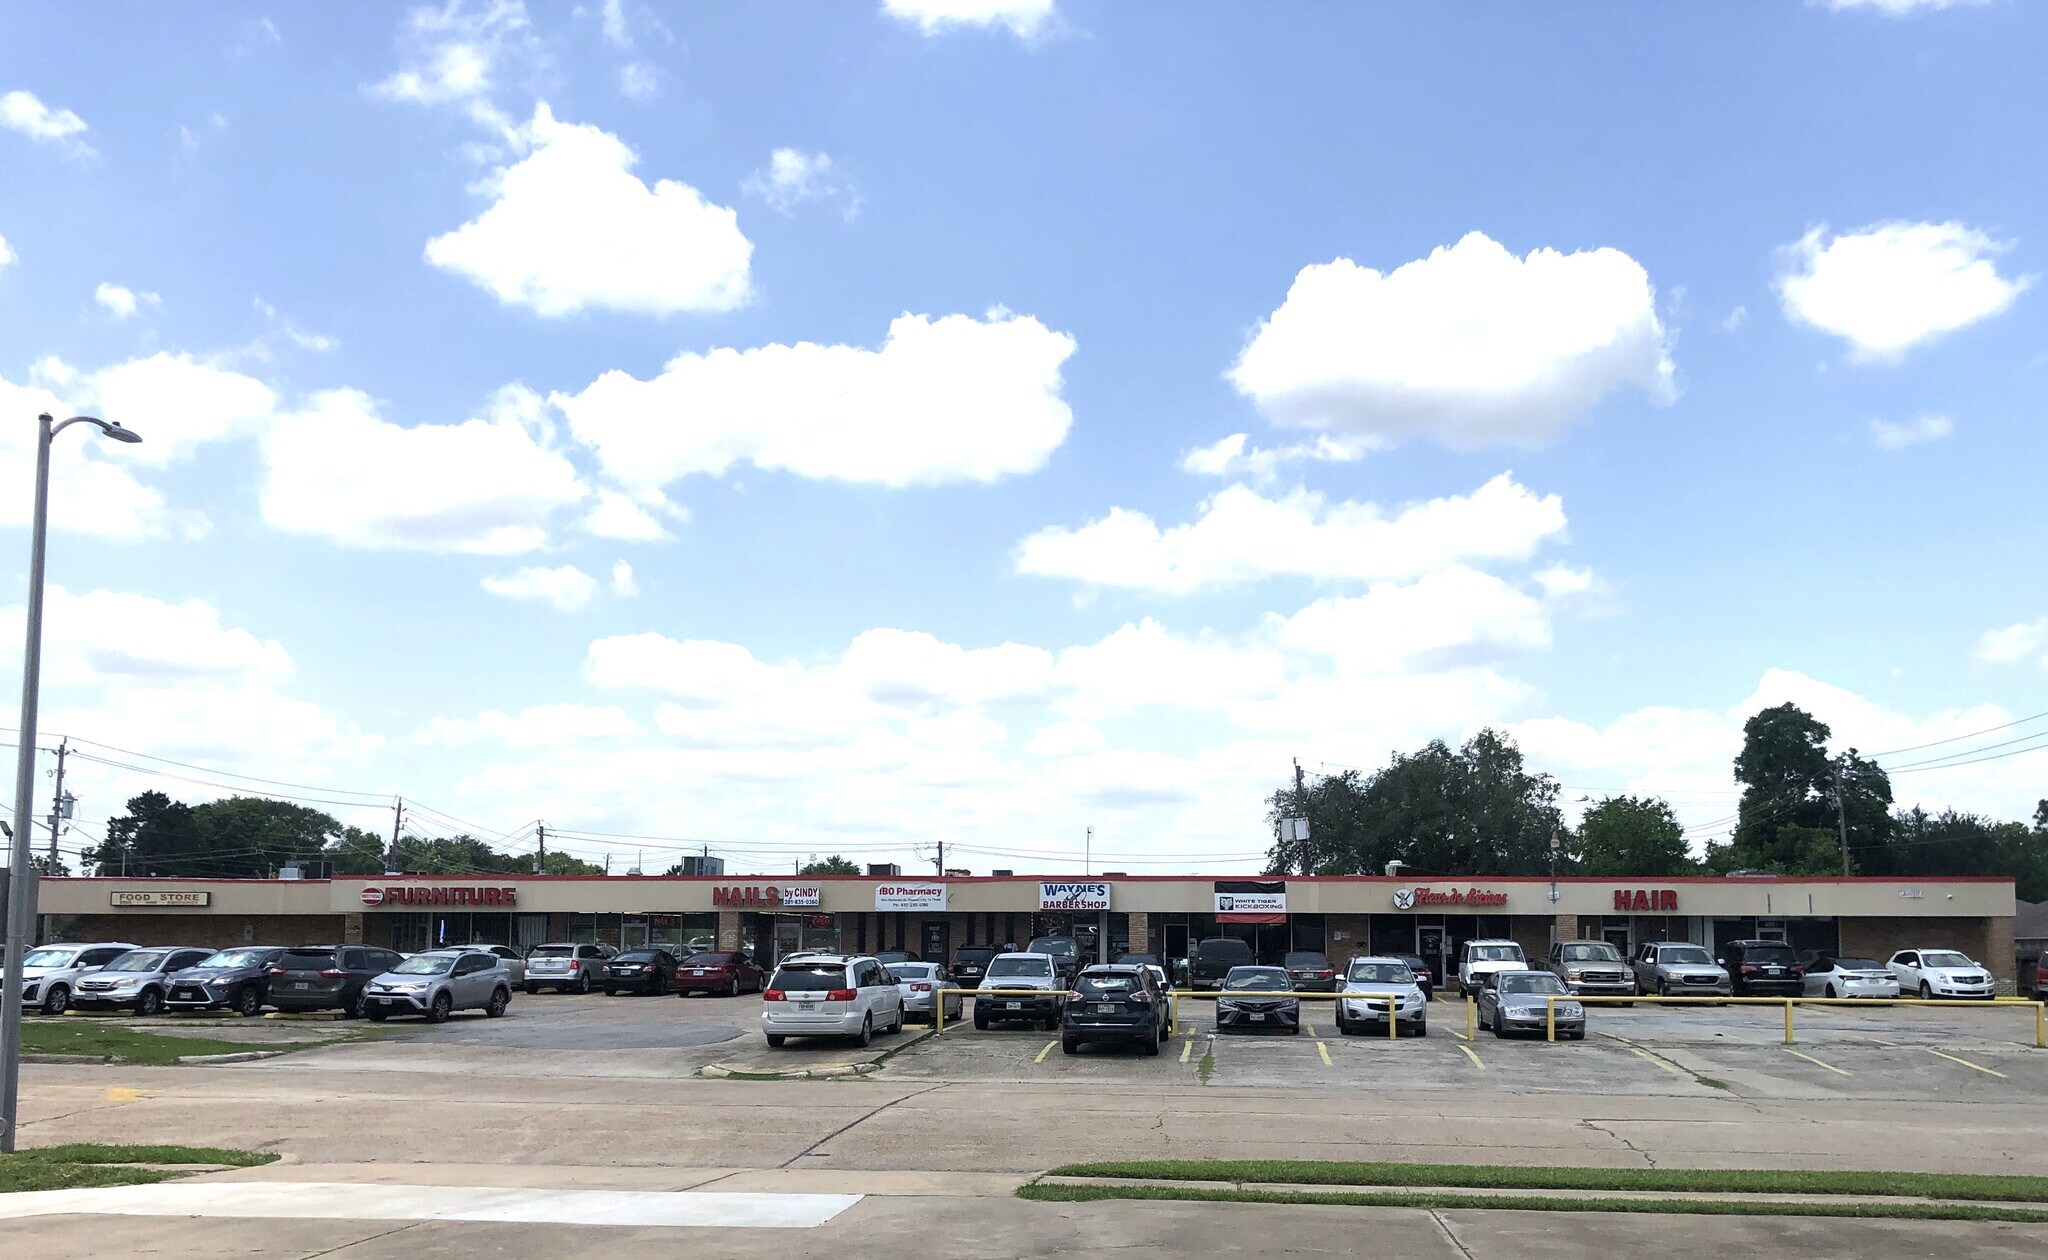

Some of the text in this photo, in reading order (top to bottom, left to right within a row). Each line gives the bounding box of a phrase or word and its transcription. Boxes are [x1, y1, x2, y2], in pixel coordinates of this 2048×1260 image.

[119, 893, 200, 901] FOOD STORE
[384, 887, 517, 906] FURNITURE
[712, 886, 780, 907] NAILS
[784, 887, 819, 898] by CINDY
[896, 887, 943, 897] Pharmacy
[1044, 884, 1106, 897] WAYNE'S
[1449, 887, 1464, 904] de
[1614, 889, 1678, 911] HAIR
